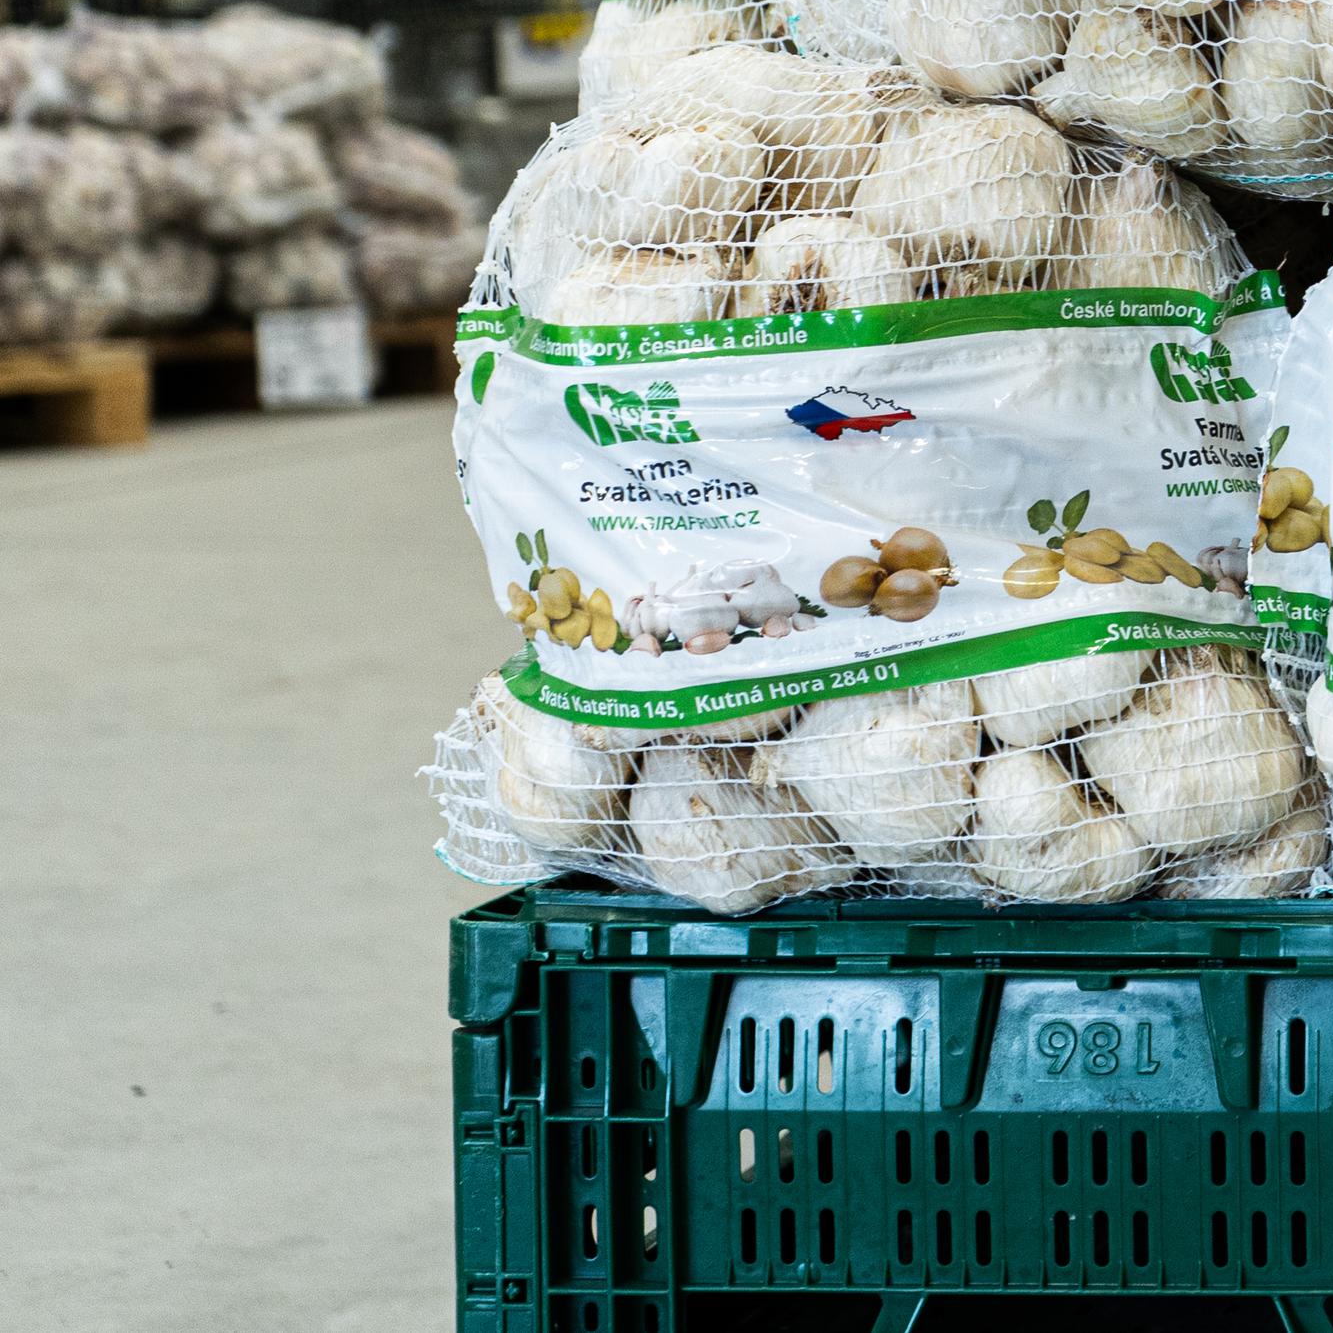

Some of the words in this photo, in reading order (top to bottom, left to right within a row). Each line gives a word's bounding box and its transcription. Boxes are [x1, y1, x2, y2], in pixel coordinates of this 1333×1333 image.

[1060, 298, 1115, 320] České
[1120, 301, 1206, 326] brambory,
[639, 334, 716, 355] česnek
[723, 336, 736, 350] a
[742, 327, 808, 348] cibule
[1195, 417, 1245, 443] Farma
[624, 459, 693, 482] arma
[1160, 446, 1219, 471] Svatá
[1222, 444, 1265, 469] Kateř
[580, 481, 651, 502] Svatá
[1107, 623, 1161, 643] Svatá
[1164, 624, 1239, 643] Kateřina
[539, 685, 570, 711] Svatá
[571, 696, 641, 719] Kateřina
[644, 701, 685, 720] 145,
[695, 685, 764, 714] Kutná
[768, 678, 825, 700] Hora
[830, 667, 869, 689] 284
[874, 662, 900, 681] 01
